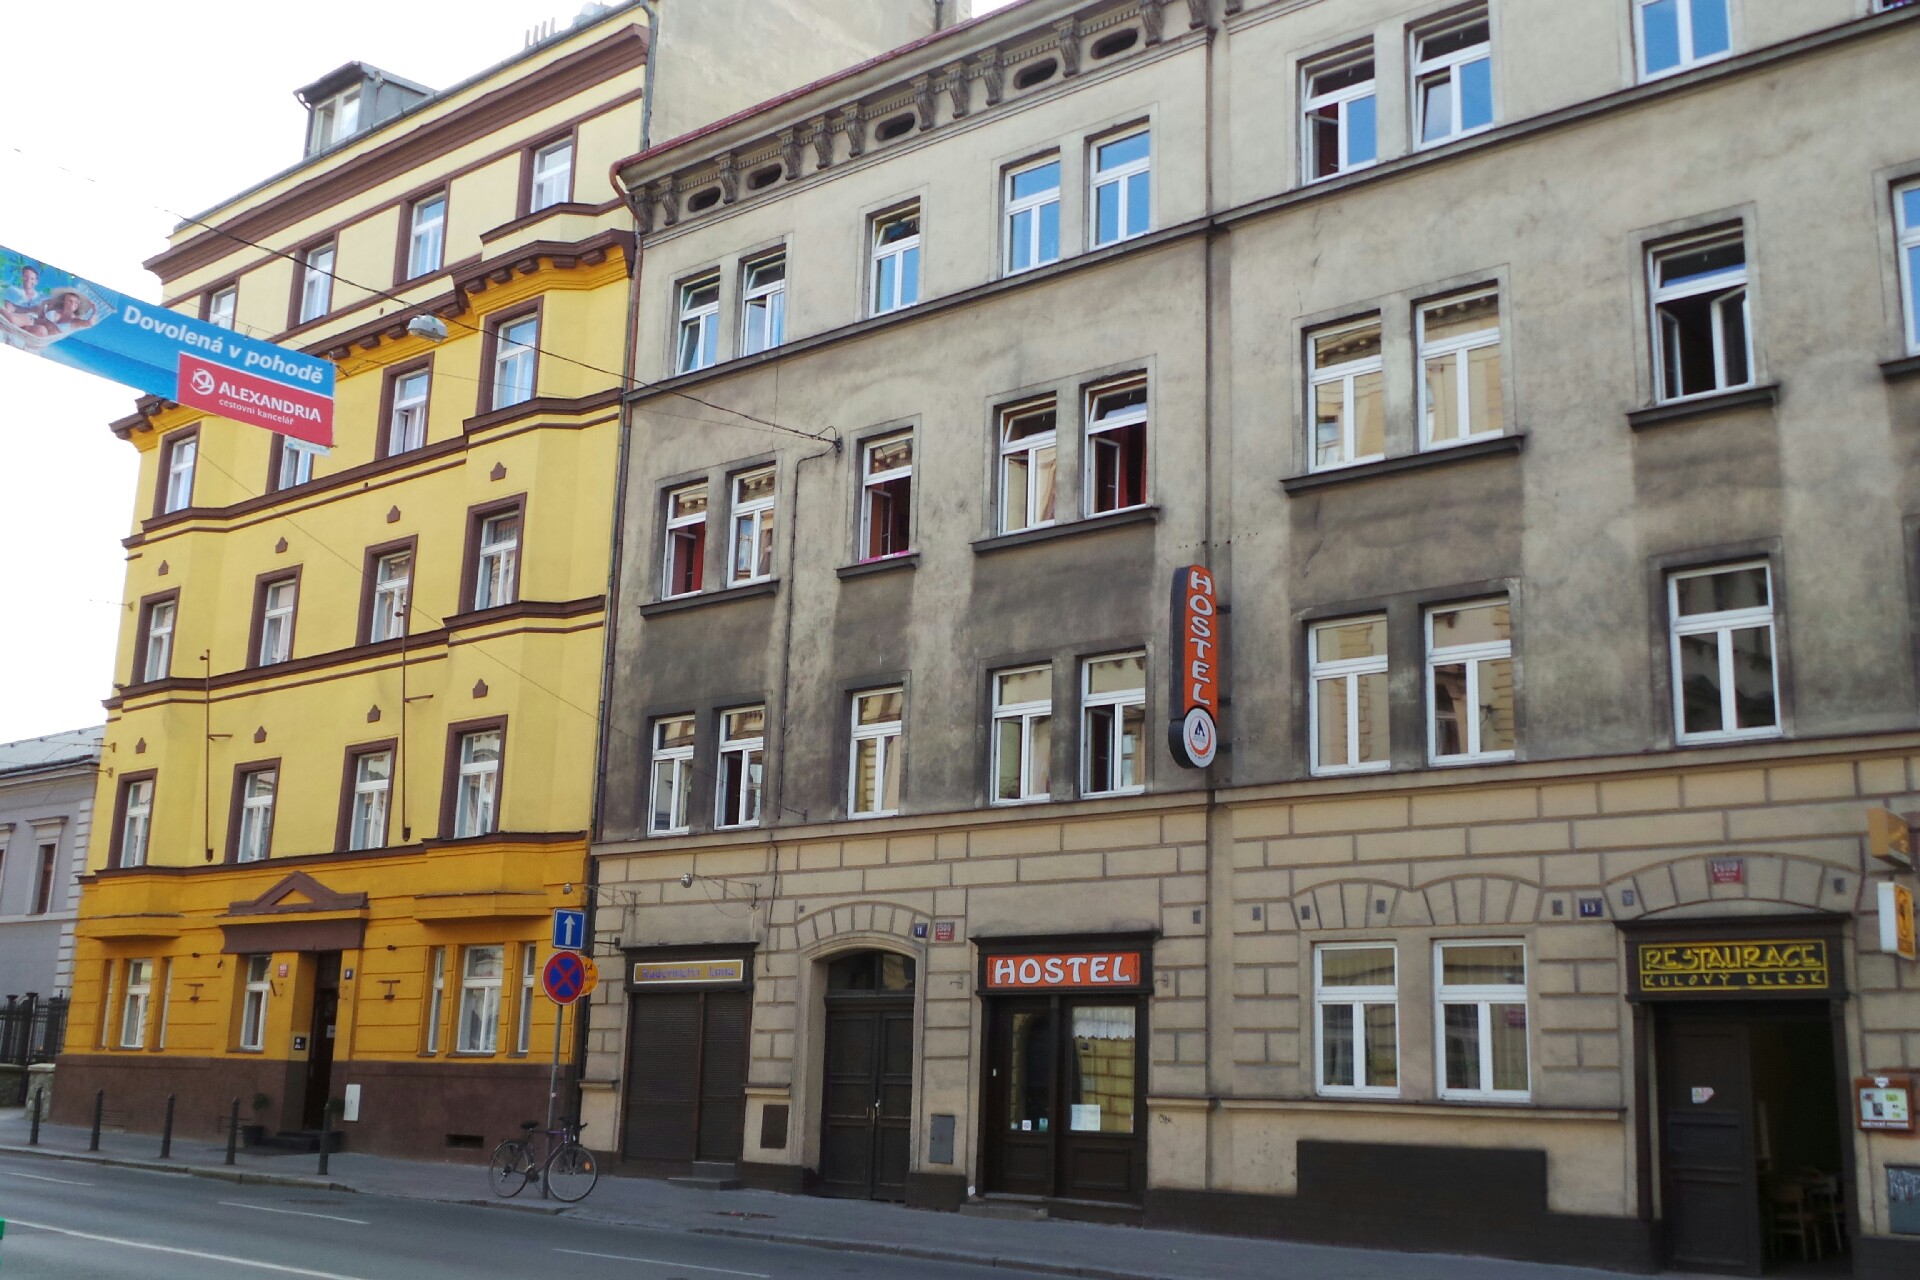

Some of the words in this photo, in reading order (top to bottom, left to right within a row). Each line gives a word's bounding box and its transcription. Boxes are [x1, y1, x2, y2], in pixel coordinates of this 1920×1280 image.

[123, 304, 224, 354] Dovolená
[229, 344, 242, 359] v
[244, 351, 324, 385] pohodě
[218, 381, 322, 423] ALEXANDRIA
[218, 398, 255, 415] cestovní
[257, 410, 295, 427] kancelář
[1189, 570, 1214, 706] HOSTEL
[994, 956, 1131, 984] HOSTEL
[1645, 944, 1822, 971] RESTAURACE
[1747, 972, 1823, 984] BLESK
